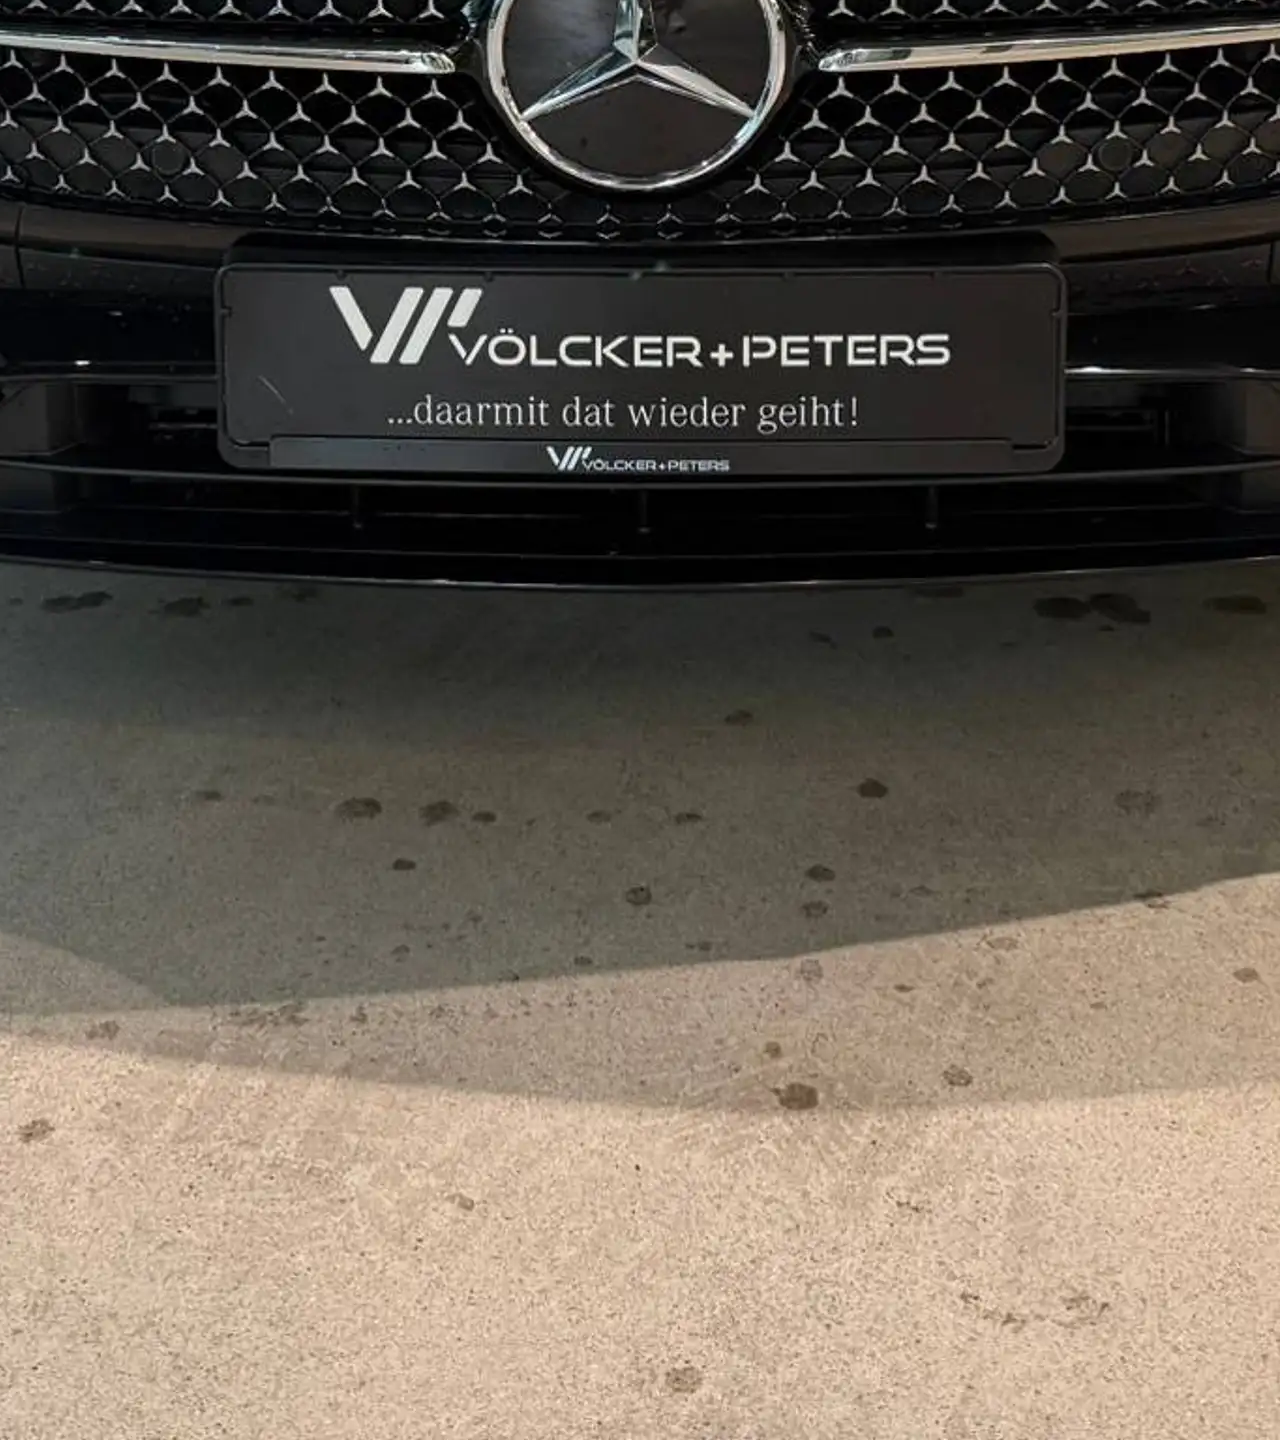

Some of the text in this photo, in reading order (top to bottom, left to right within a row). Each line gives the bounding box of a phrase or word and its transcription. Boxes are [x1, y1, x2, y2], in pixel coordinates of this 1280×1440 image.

[562, 396, 615, 427] dat
[627, 396, 746, 428] wieder
[757, 396, 859, 435] geiht!
